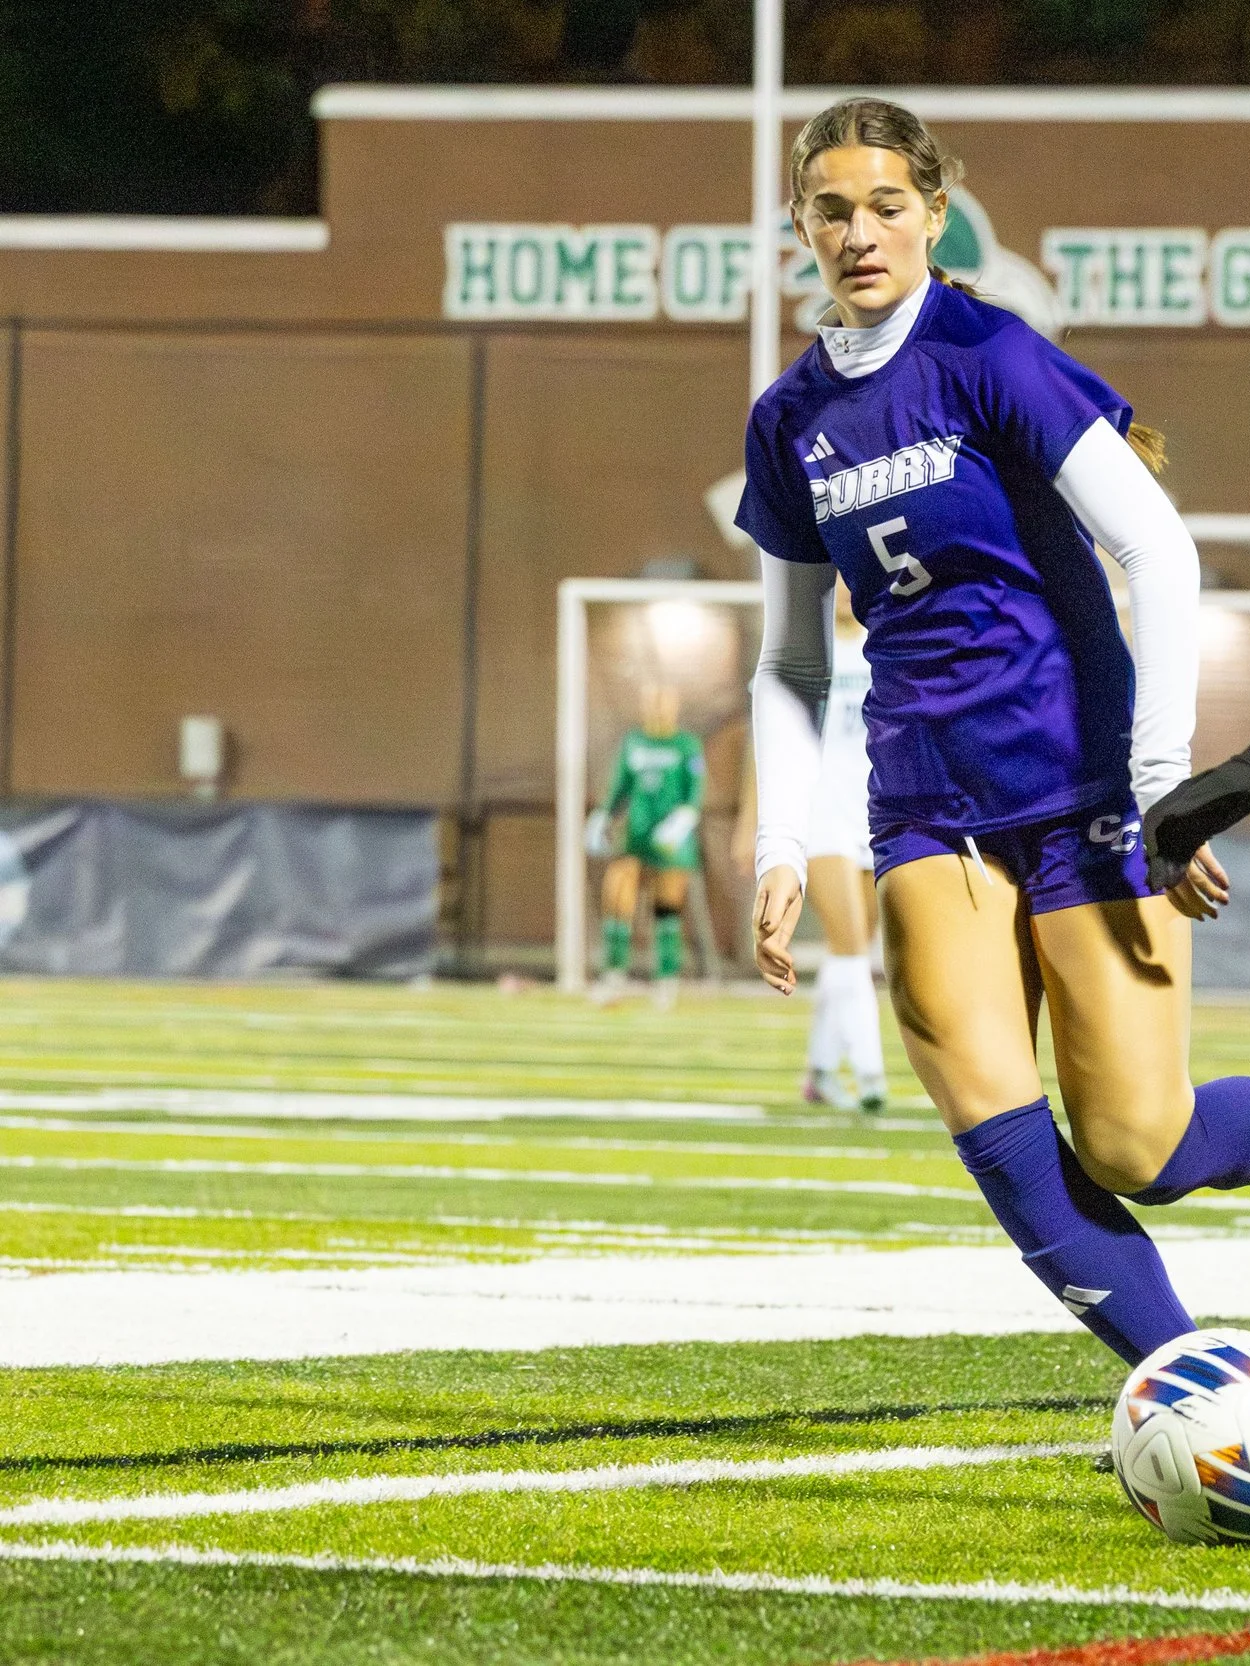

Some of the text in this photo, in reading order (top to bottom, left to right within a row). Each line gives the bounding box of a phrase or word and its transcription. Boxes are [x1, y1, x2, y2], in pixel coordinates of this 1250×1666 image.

[452, 231, 651, 313] HOME
[668, 231, 752, 313] OF
[1049, 235, 1202, 320] THE
[809, 434, 964, 524] CURRY
[866, 515, 933, 596] 5
